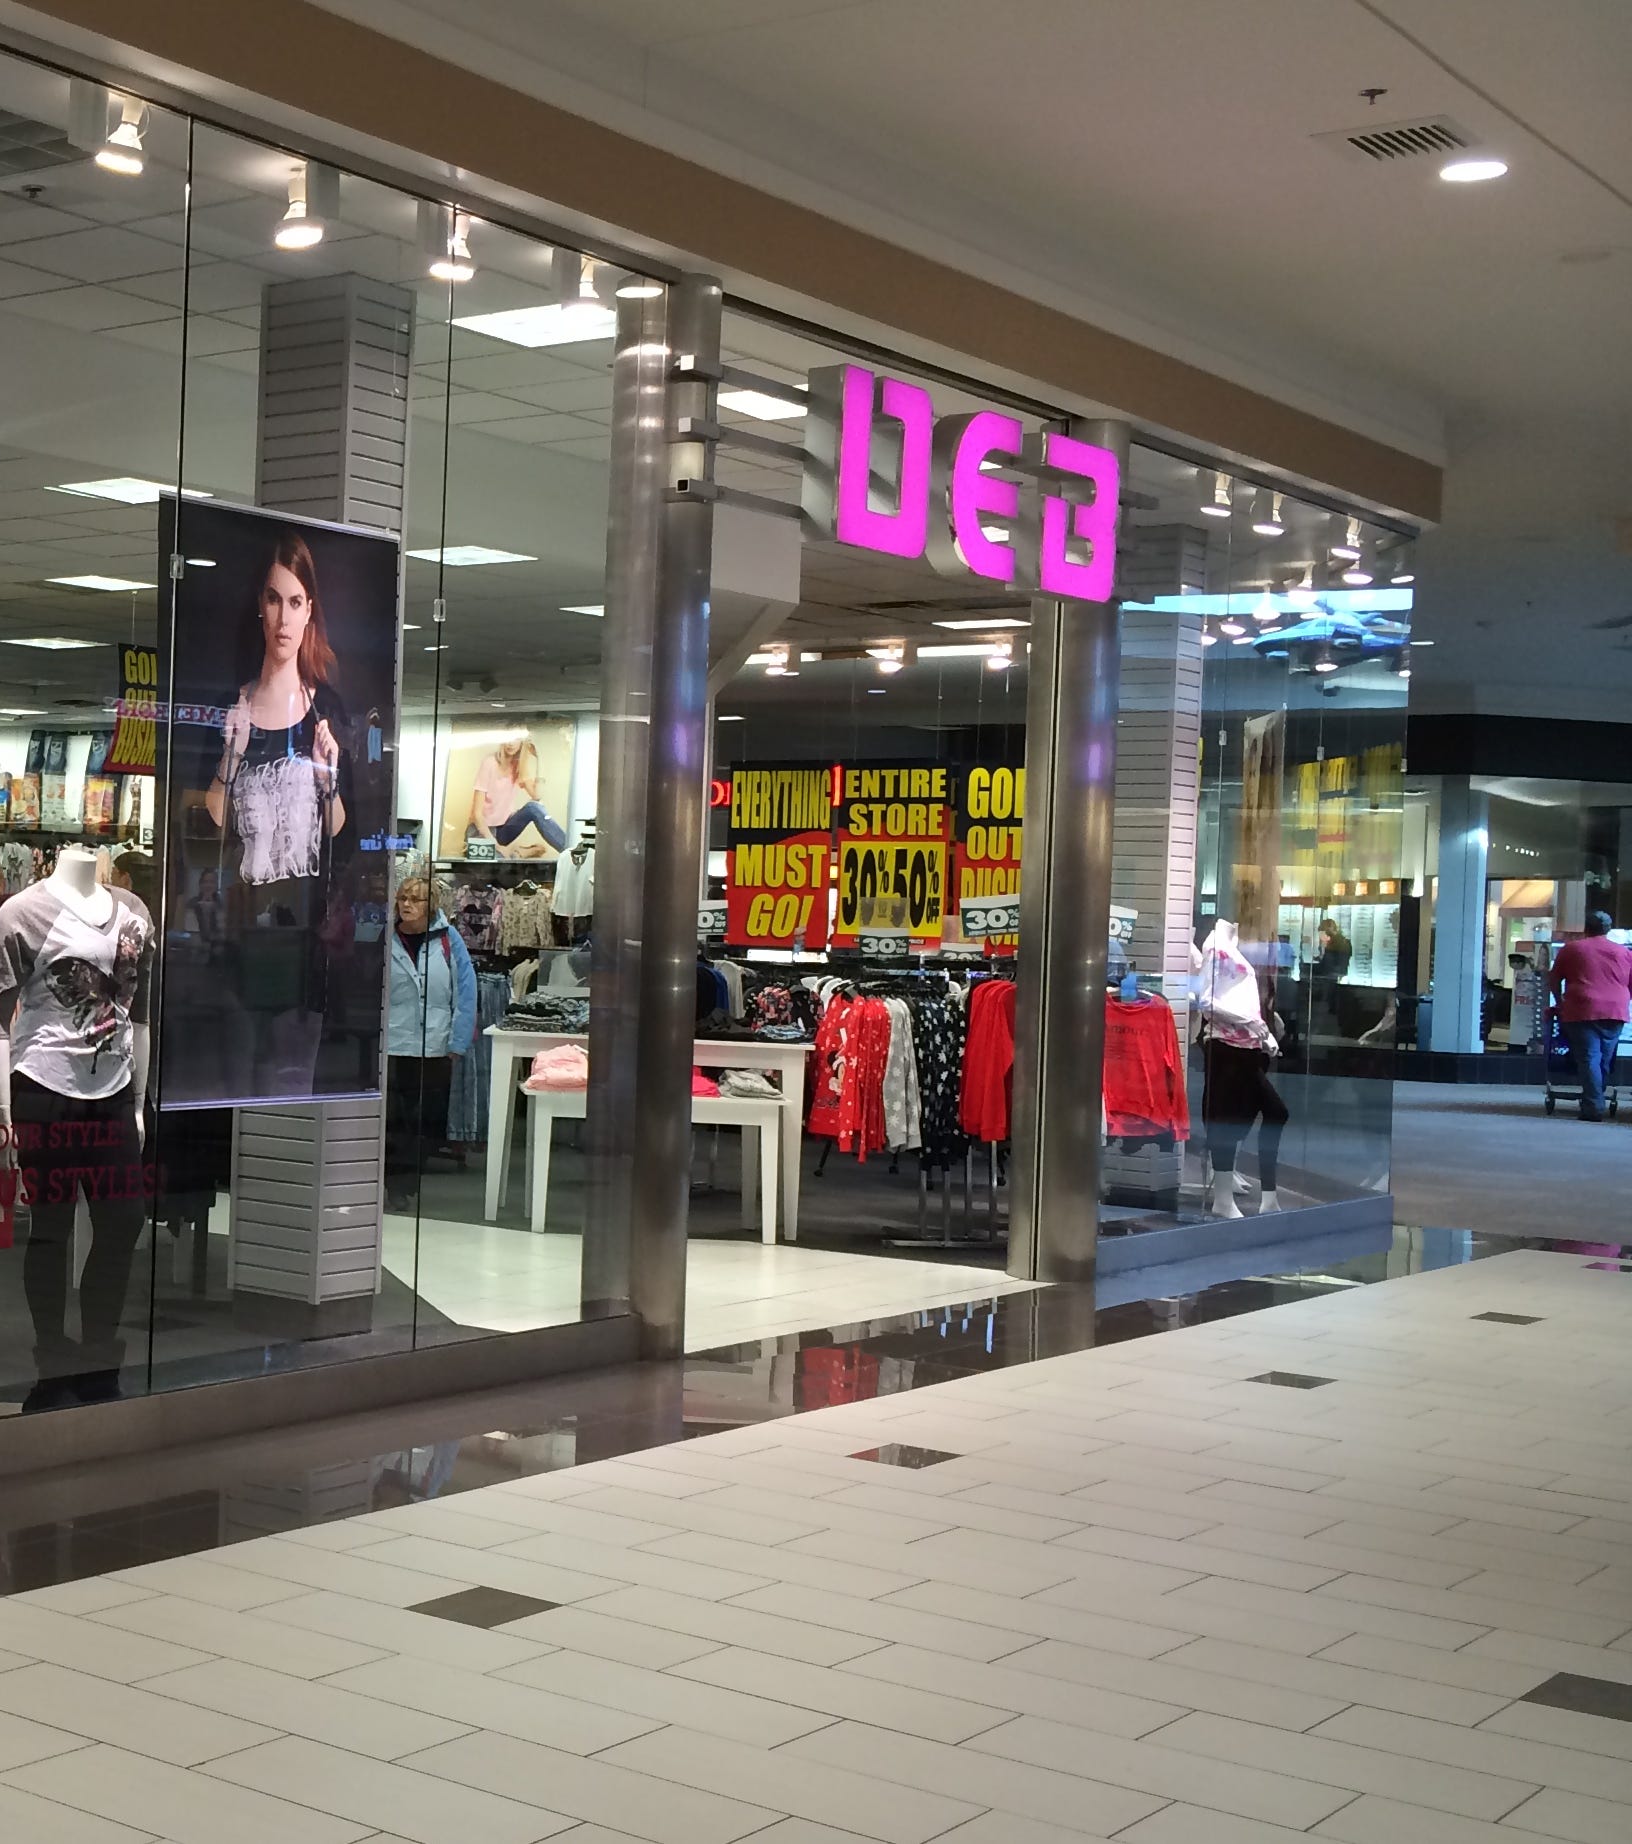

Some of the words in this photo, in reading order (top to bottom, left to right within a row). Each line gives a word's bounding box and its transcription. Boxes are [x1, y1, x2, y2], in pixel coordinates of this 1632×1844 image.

[837, 363, 1121, 603] DEB
[124, 649, 157, 686] GOI
[731, 769, 831, 830] EVERYTHING
[844, 768, 946, 799] ENTIRE
[967, 767, 1025, 820] GOI
[849, 803, 944, 836] STORE
[734, 844, 828, 888] MUST
[697, 911, 726, 928] 0%
[746, 893, 814, 938] GO!
